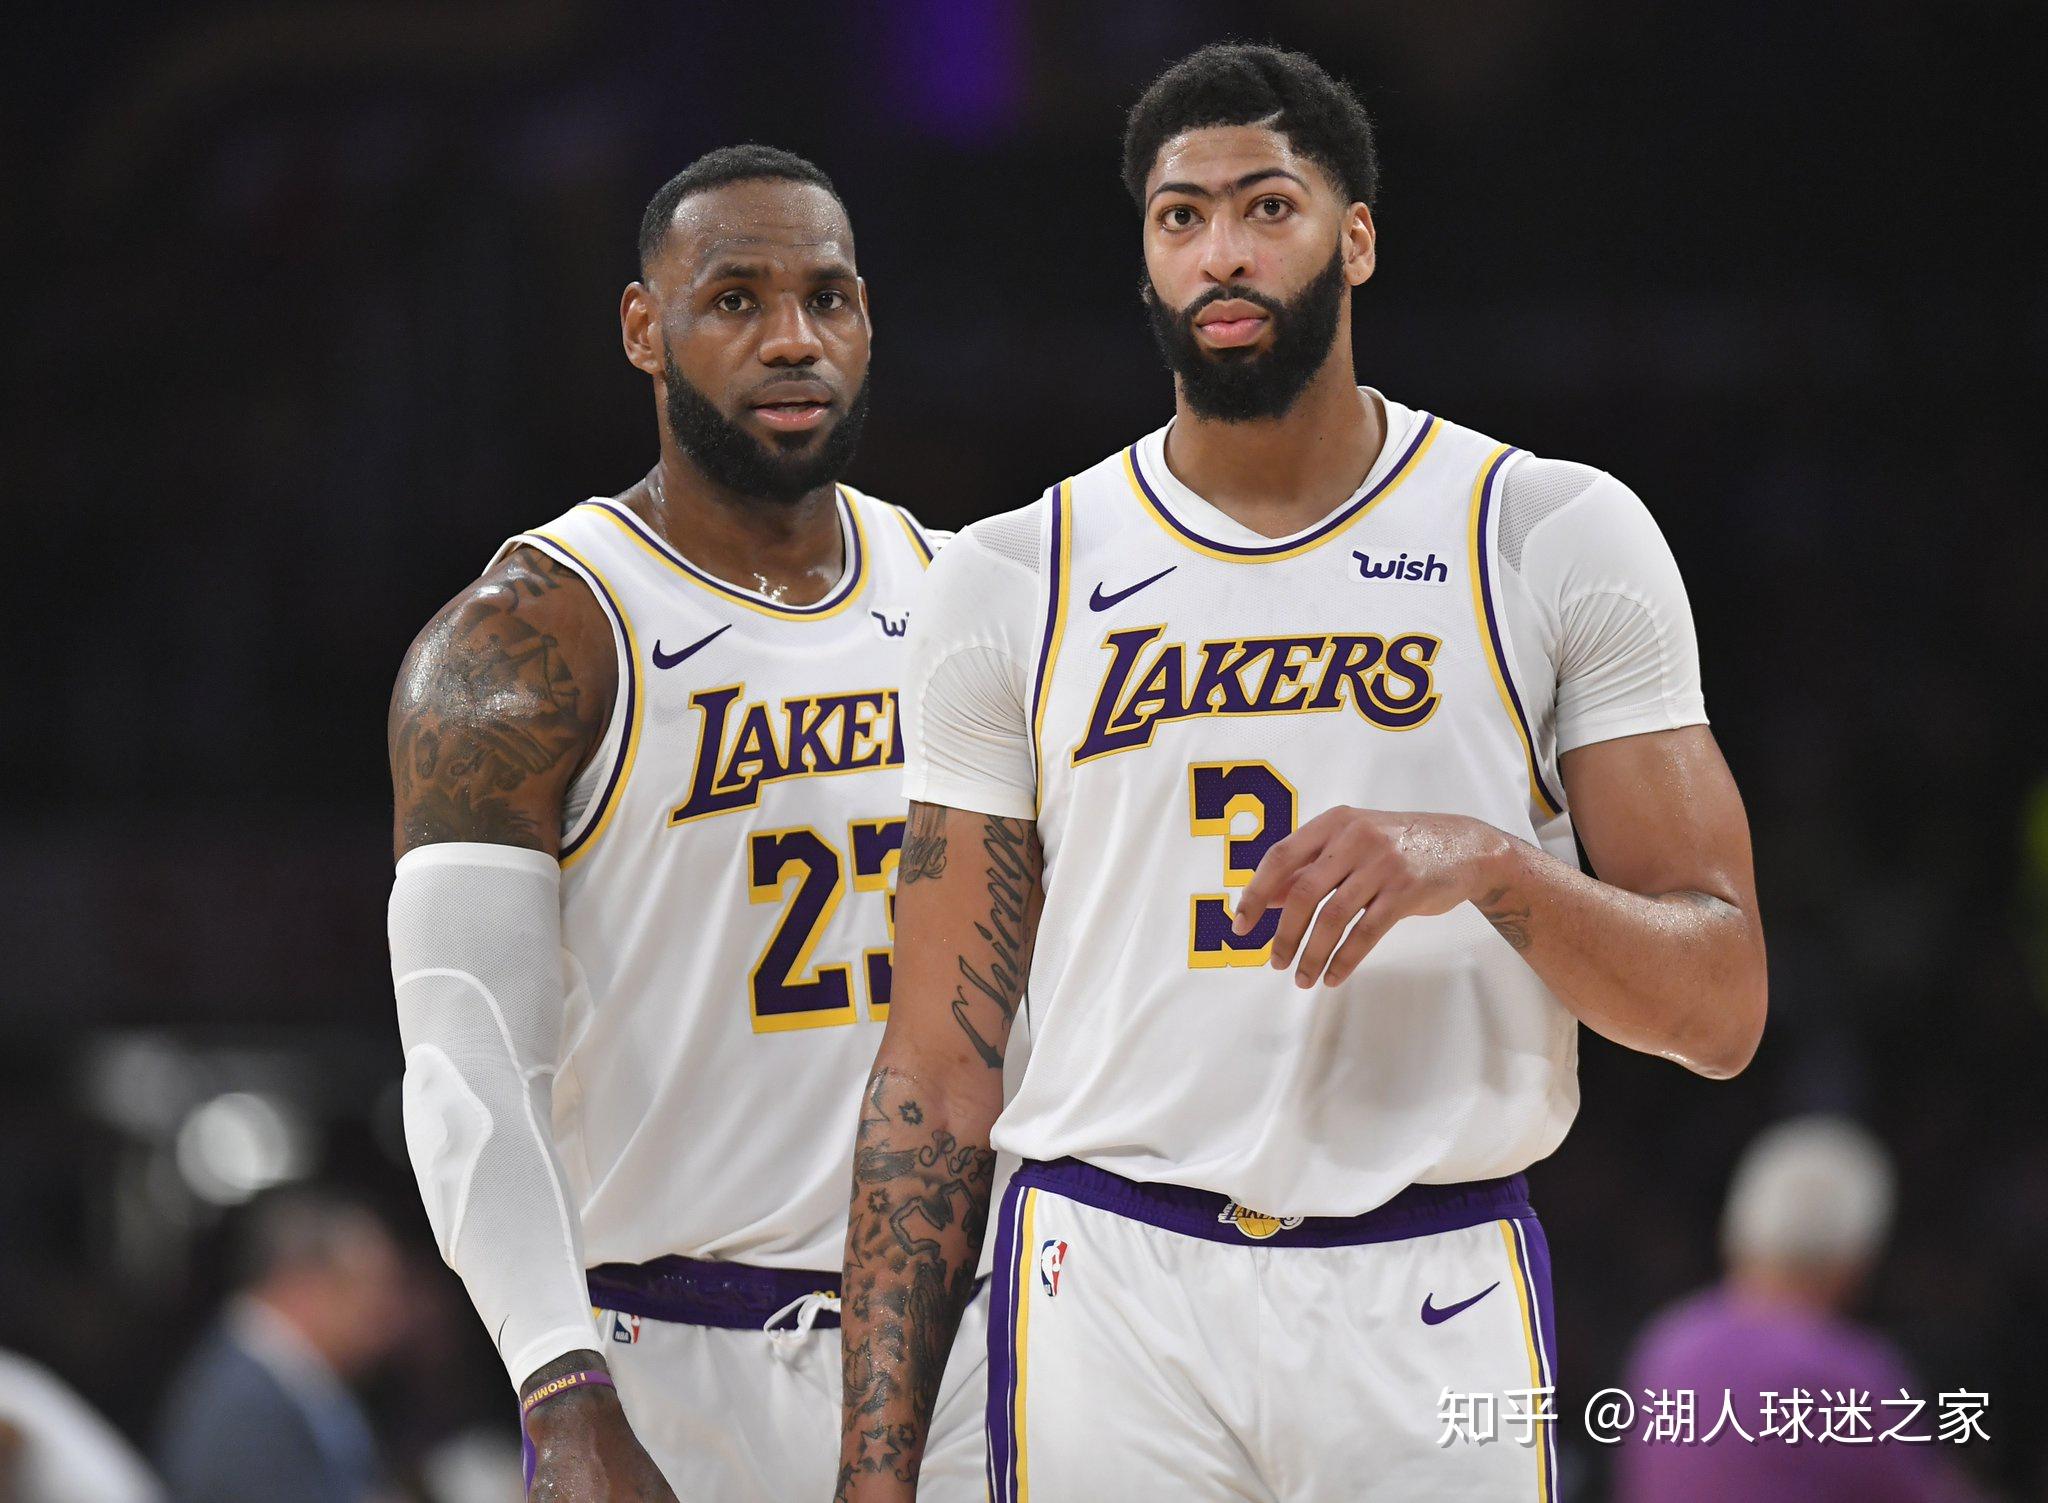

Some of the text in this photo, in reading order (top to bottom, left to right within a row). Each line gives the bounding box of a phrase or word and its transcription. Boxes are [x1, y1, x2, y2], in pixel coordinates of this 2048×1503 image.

[1352, 550, 1448, 582] wish
[1071, 622, 1443, 768] LAKERS
[1188, 759, 1298, 969] 3
[580, 1372, 586, 1381] I
